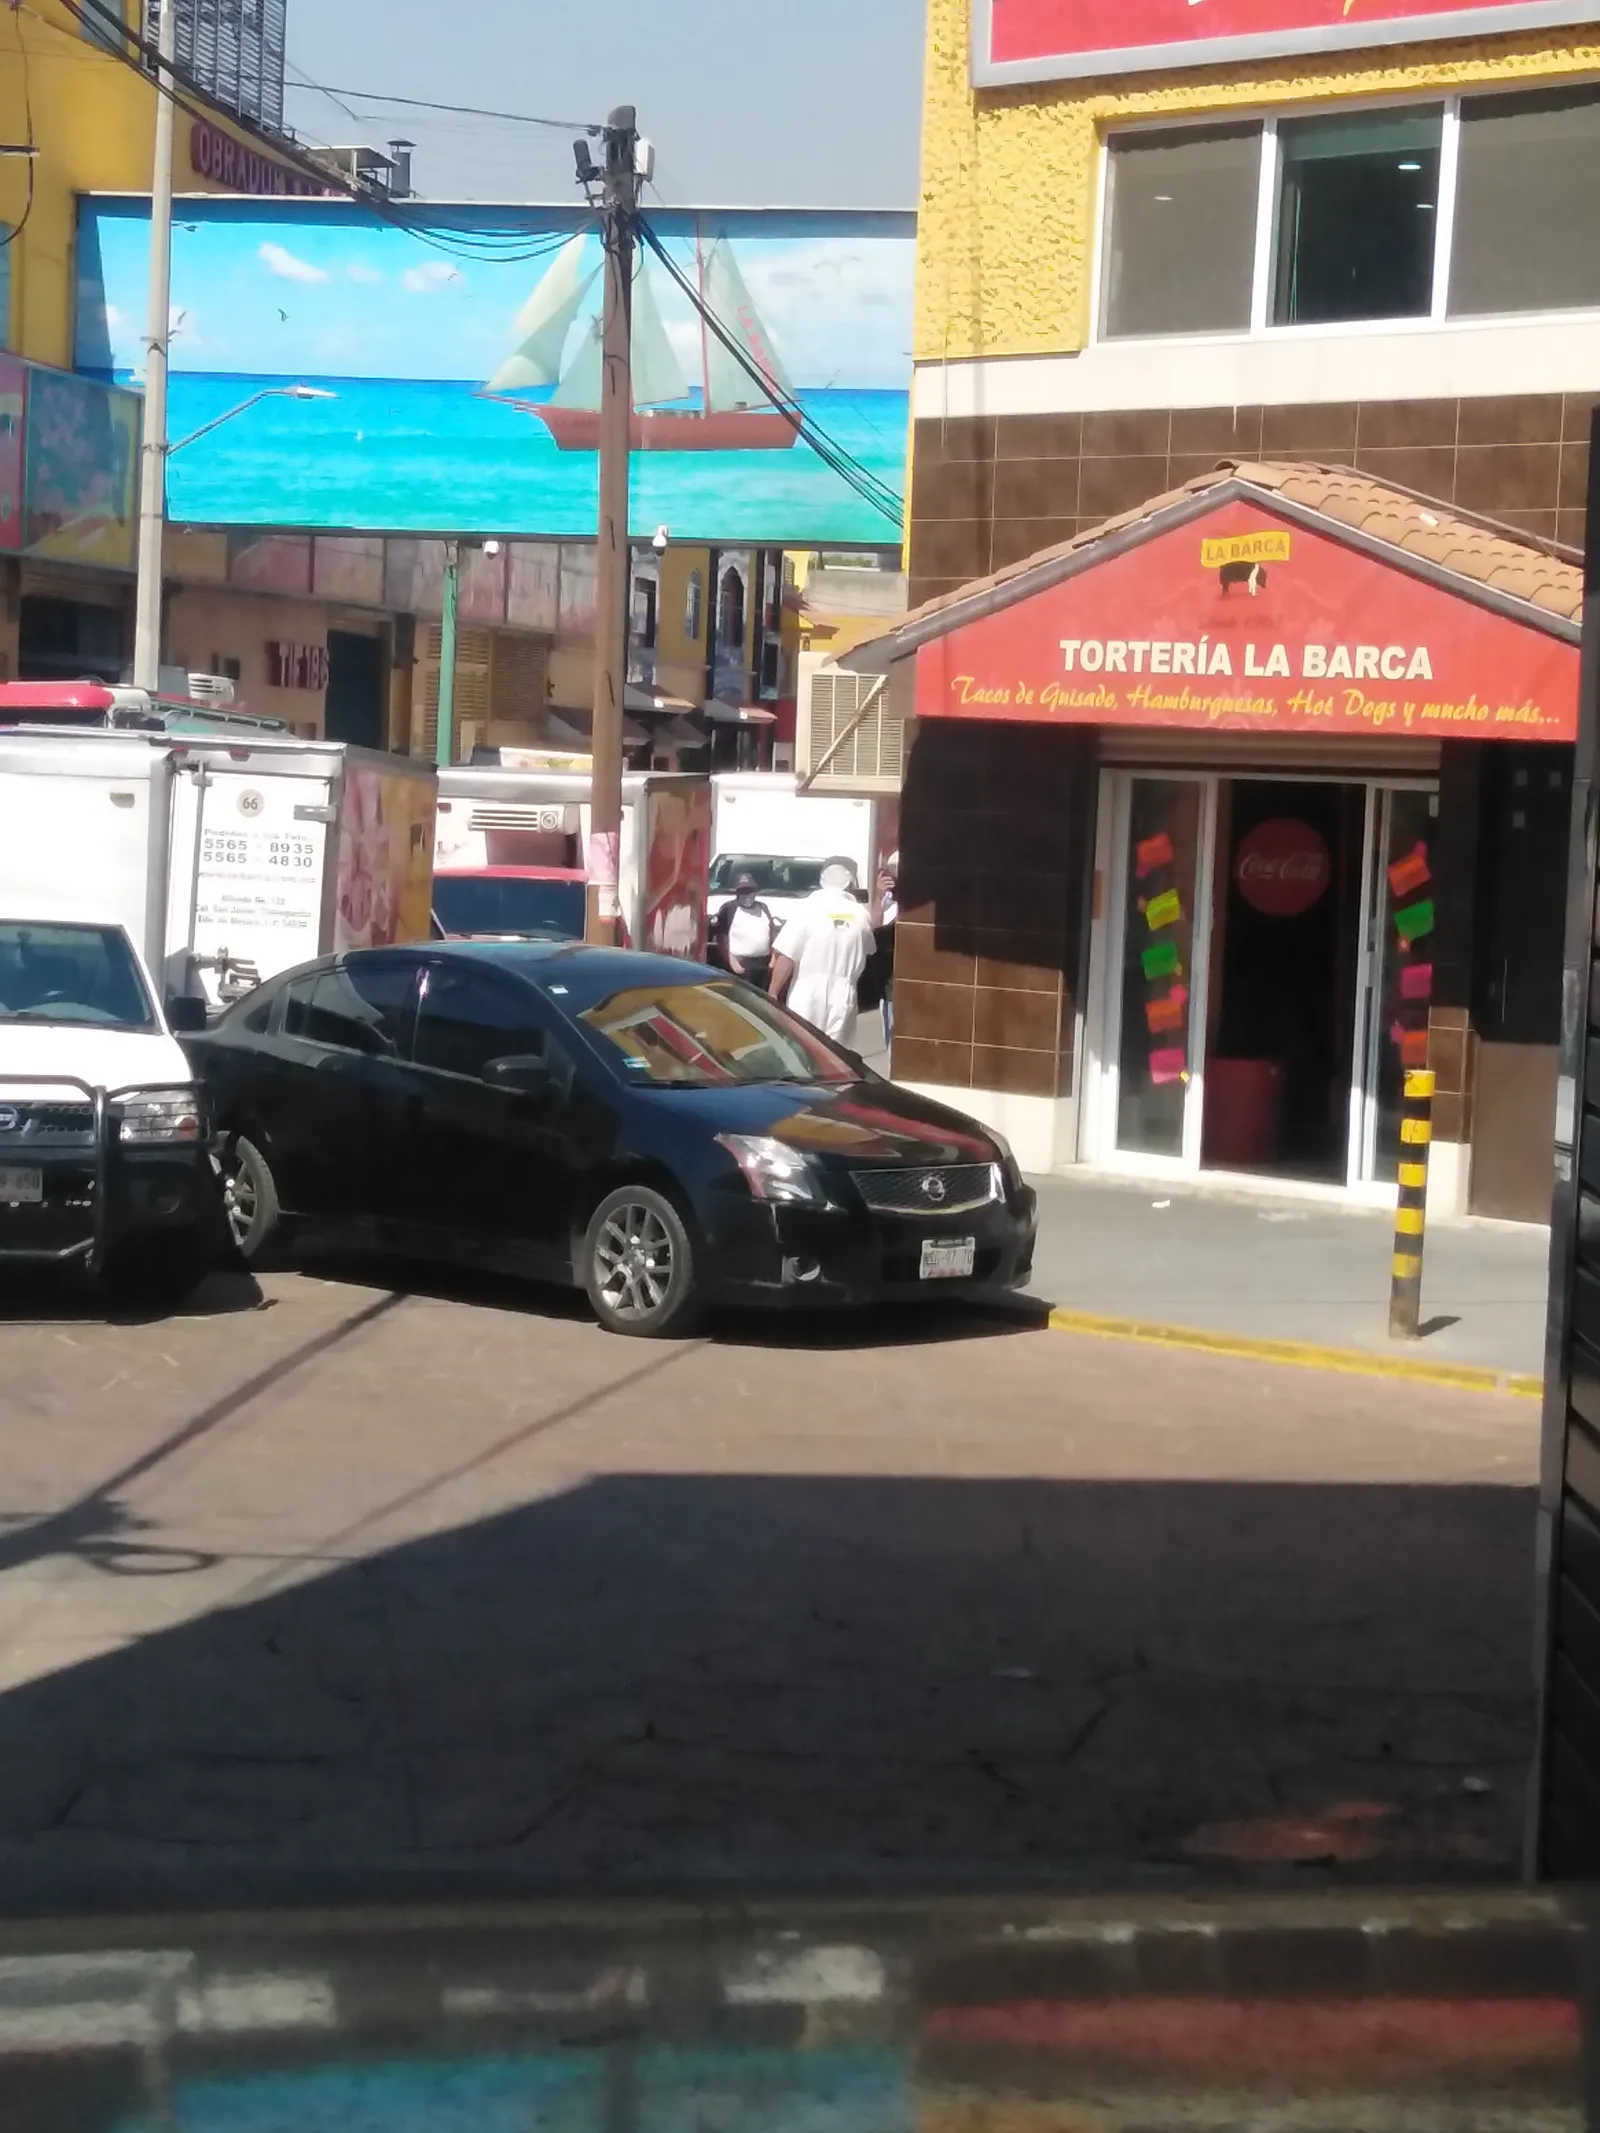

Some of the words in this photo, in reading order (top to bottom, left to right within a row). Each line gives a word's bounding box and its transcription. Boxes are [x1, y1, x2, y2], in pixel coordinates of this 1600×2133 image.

[1206, 546, 1226, 561] LA
[1231, 539, 1286, 558] BARCA
[1060, 635, 1233, 676] TORTERÍA
[1244, 643, 1290, 678] LA
[1303, 644, 1433, 680] BARCA
[951, 676, 1010, 705] Tacos
[1016, 682, 1035, 705] de
[1286, 689, 1335, 716] Hot
[1342, 688, 1395, 726] Dogs
[1402, 702, 1416, 727] y
[1422, 694, 1489, 722] mucho
[242, 796, 258, 811] 66
[204, 838, 248, 850] 5565
[269, 842, 314, 855] 8935
[203, 851, 247, 864] 5565
[268, 855, 313, 868] 4830
